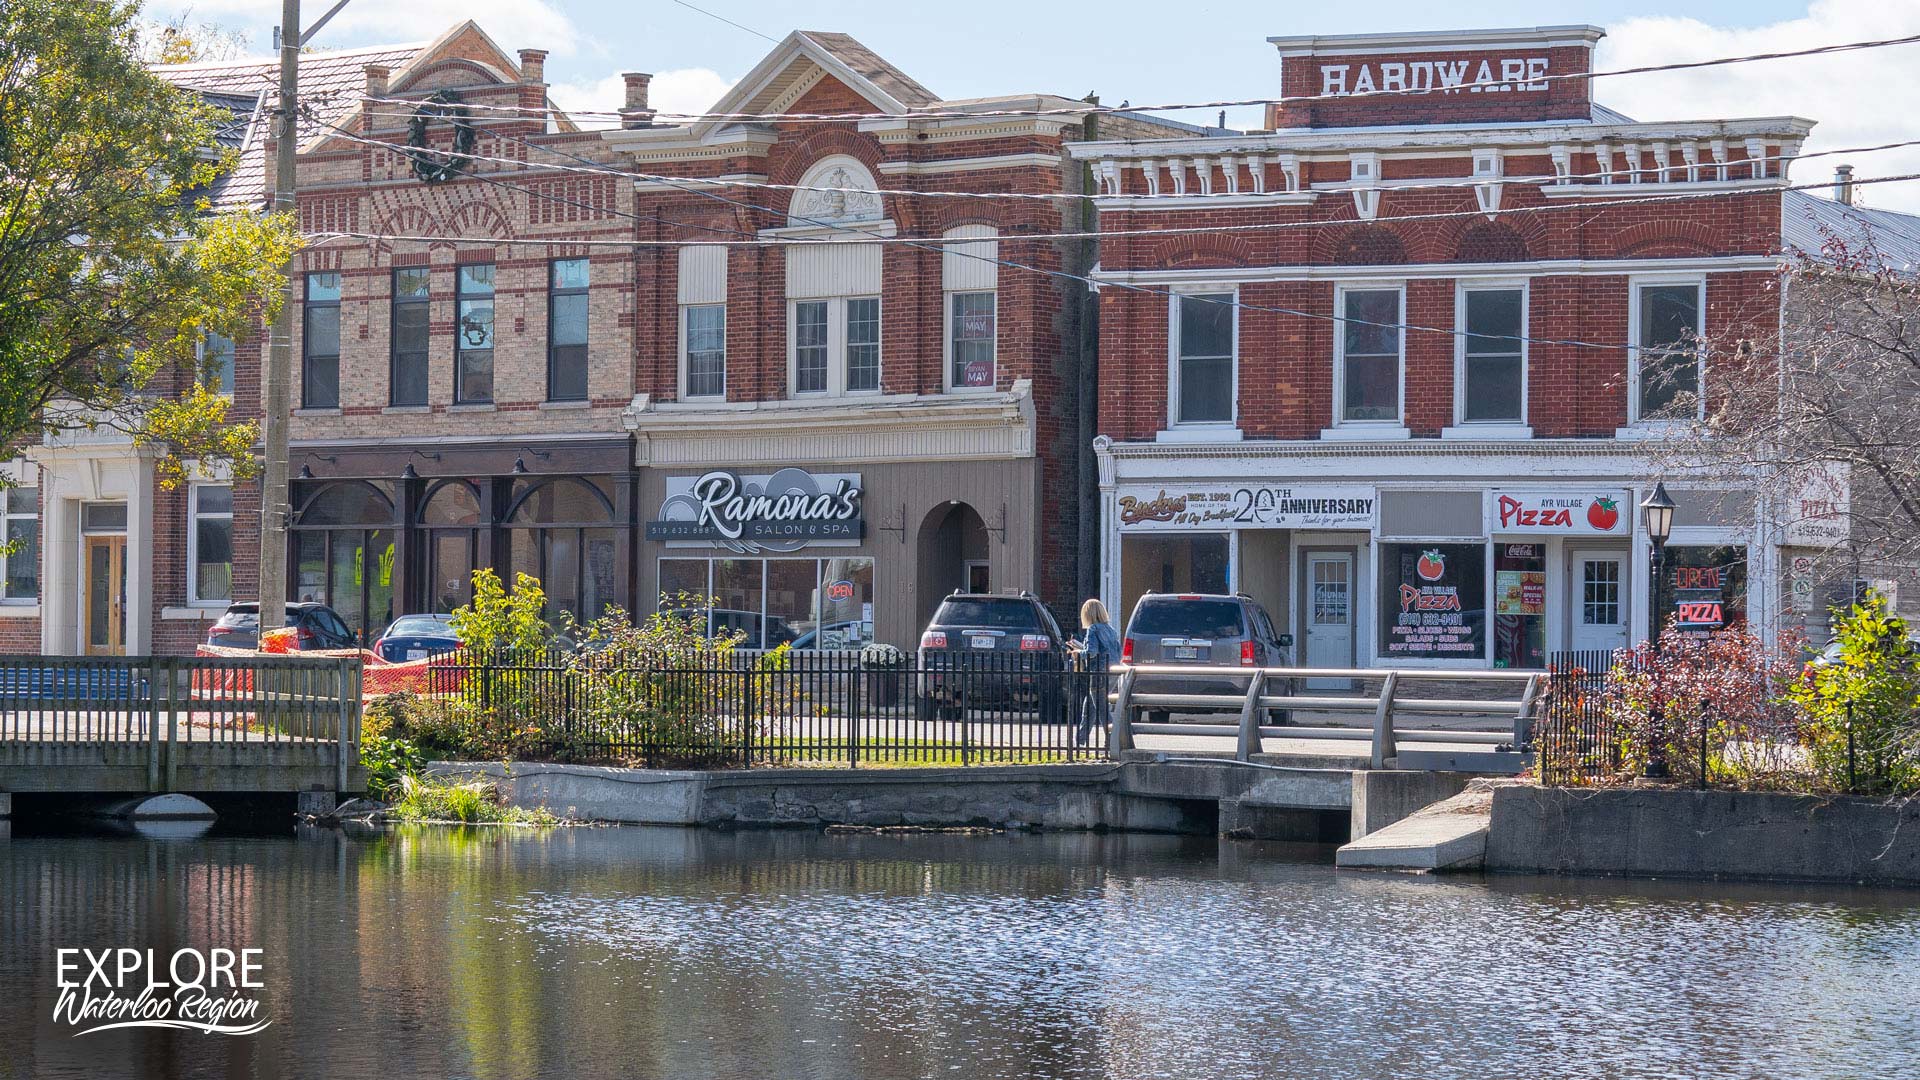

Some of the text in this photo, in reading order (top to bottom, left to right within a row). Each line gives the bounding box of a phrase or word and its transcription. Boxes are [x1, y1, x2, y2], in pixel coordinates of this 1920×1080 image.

[1320, 58, 1549, 96] HARDWARE
[967, 372, 988, 382] MAY
[1187, 493, 1208, 501] EST.
[1541, 499, 1583, 508] AYR VILLAGE
[694, 472, 859, 538] Ramona's
[1280, 498, 1374, 514] ANNIVERSARY
[1498, 494, 1572, 528] Pizza
[755, 525, 850, 534] SALON & SPA
[1677, 567, 1720, 588] OPEN
[827, 584, 853, 598] OPEN
[1399, 583, 1461, 612] Pizza
[1679, 603, 1723, 622] PIZZA
[1392, 626, 1414, 634] PIZZA
[1405, 635, 1459, 643] SALADS SUBS
[1389, 643, 1409, 651] SOFT
